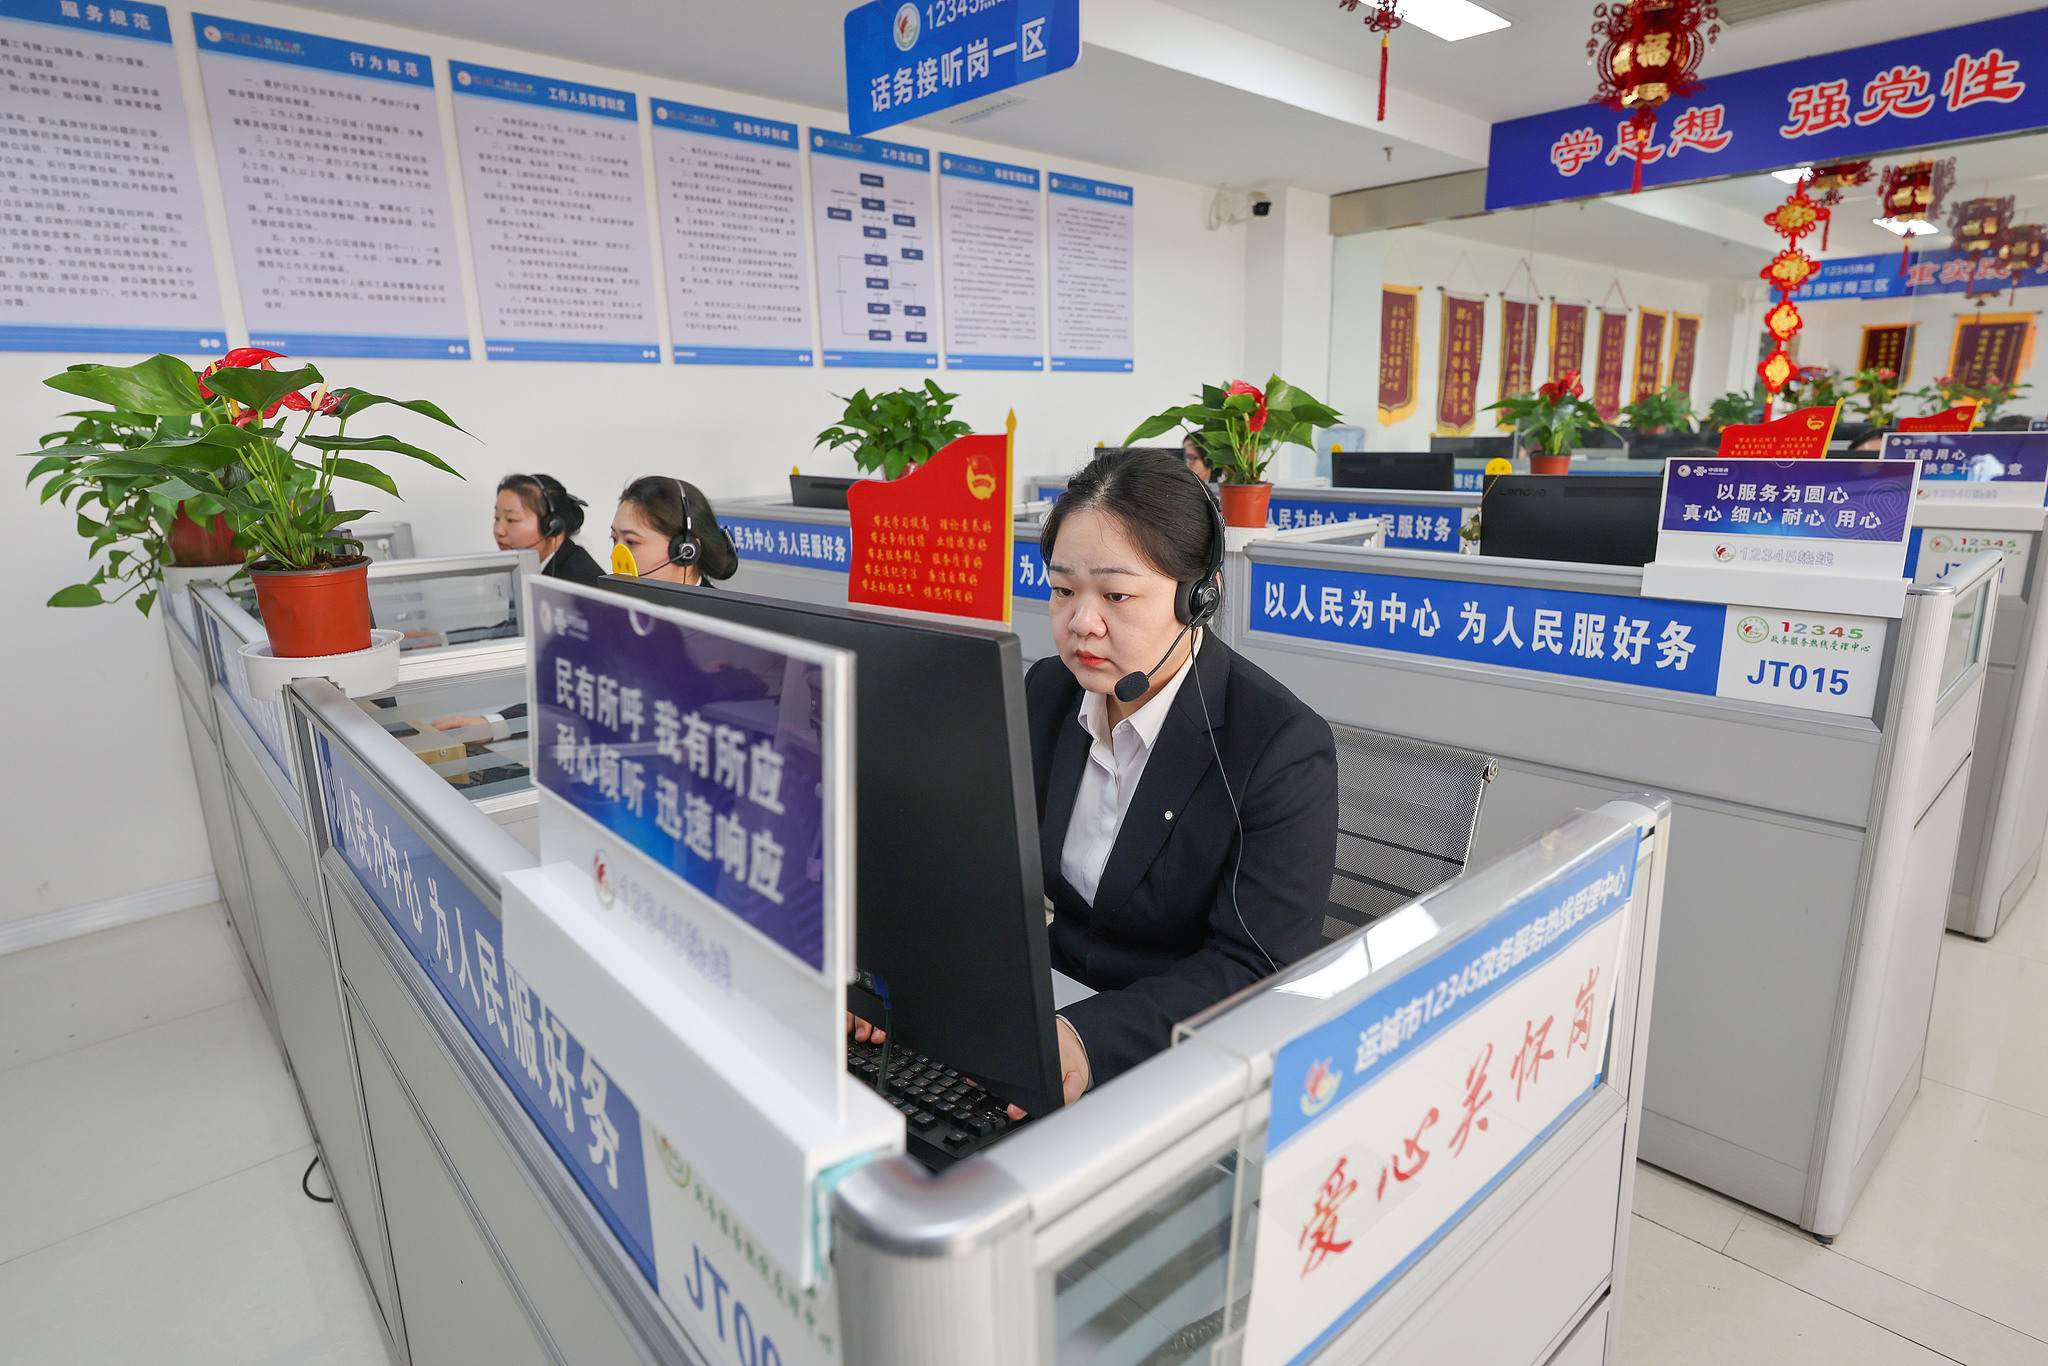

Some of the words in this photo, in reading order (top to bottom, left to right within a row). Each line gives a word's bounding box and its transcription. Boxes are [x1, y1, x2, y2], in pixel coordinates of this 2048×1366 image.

[61, 1, 152, 30] 服务规范
[926, 0, 1000, 30] 12345
[349, 52, 419, 78] 行为规范
[871, 16, 1047, 113] 话务接听岗一区
[548, 87, 627, 113] 工作人员管理制度
[1550, 104, 1733, 176] 学思想
[1779, 48, 2026, 139] 强党性
[1716, 483, 1849, 504] 以服务为圆心
[1683, 504, 1723, 522] 真心
[1730, 505, 1773, 525] 细心
[1781, 508, 1825, 527] 耐心
[1835, 510, 1882, 530] 用心
[778, 530, 847, 563] 为人民服好务
[1739, 546, 1834, 567] 12345热线
[1961, 537, 2017, 548] 12345
[1264, 581, 1442, 639] 以人民为中心
[1457, 600, 1697, 671] 为人民服好务
[1781, 621, 1864, 640] 12345
[1770, 634, 1871, 653] 政务服务热线受理中心
[1747, 659, 1850, 696] JT015
[554, 656, 645, 743] 民有所呼
[654, 698, 787, 816] 我有所应
[556, 721, 646, 819] 耐心倾听
[654, 774, 787, 906] 迅速响应
[1354, 863, 1628, 1075] 运城市12345政务服务热线受理中心
[1299, 966, 1601, 1279] 爱心关怀岗
